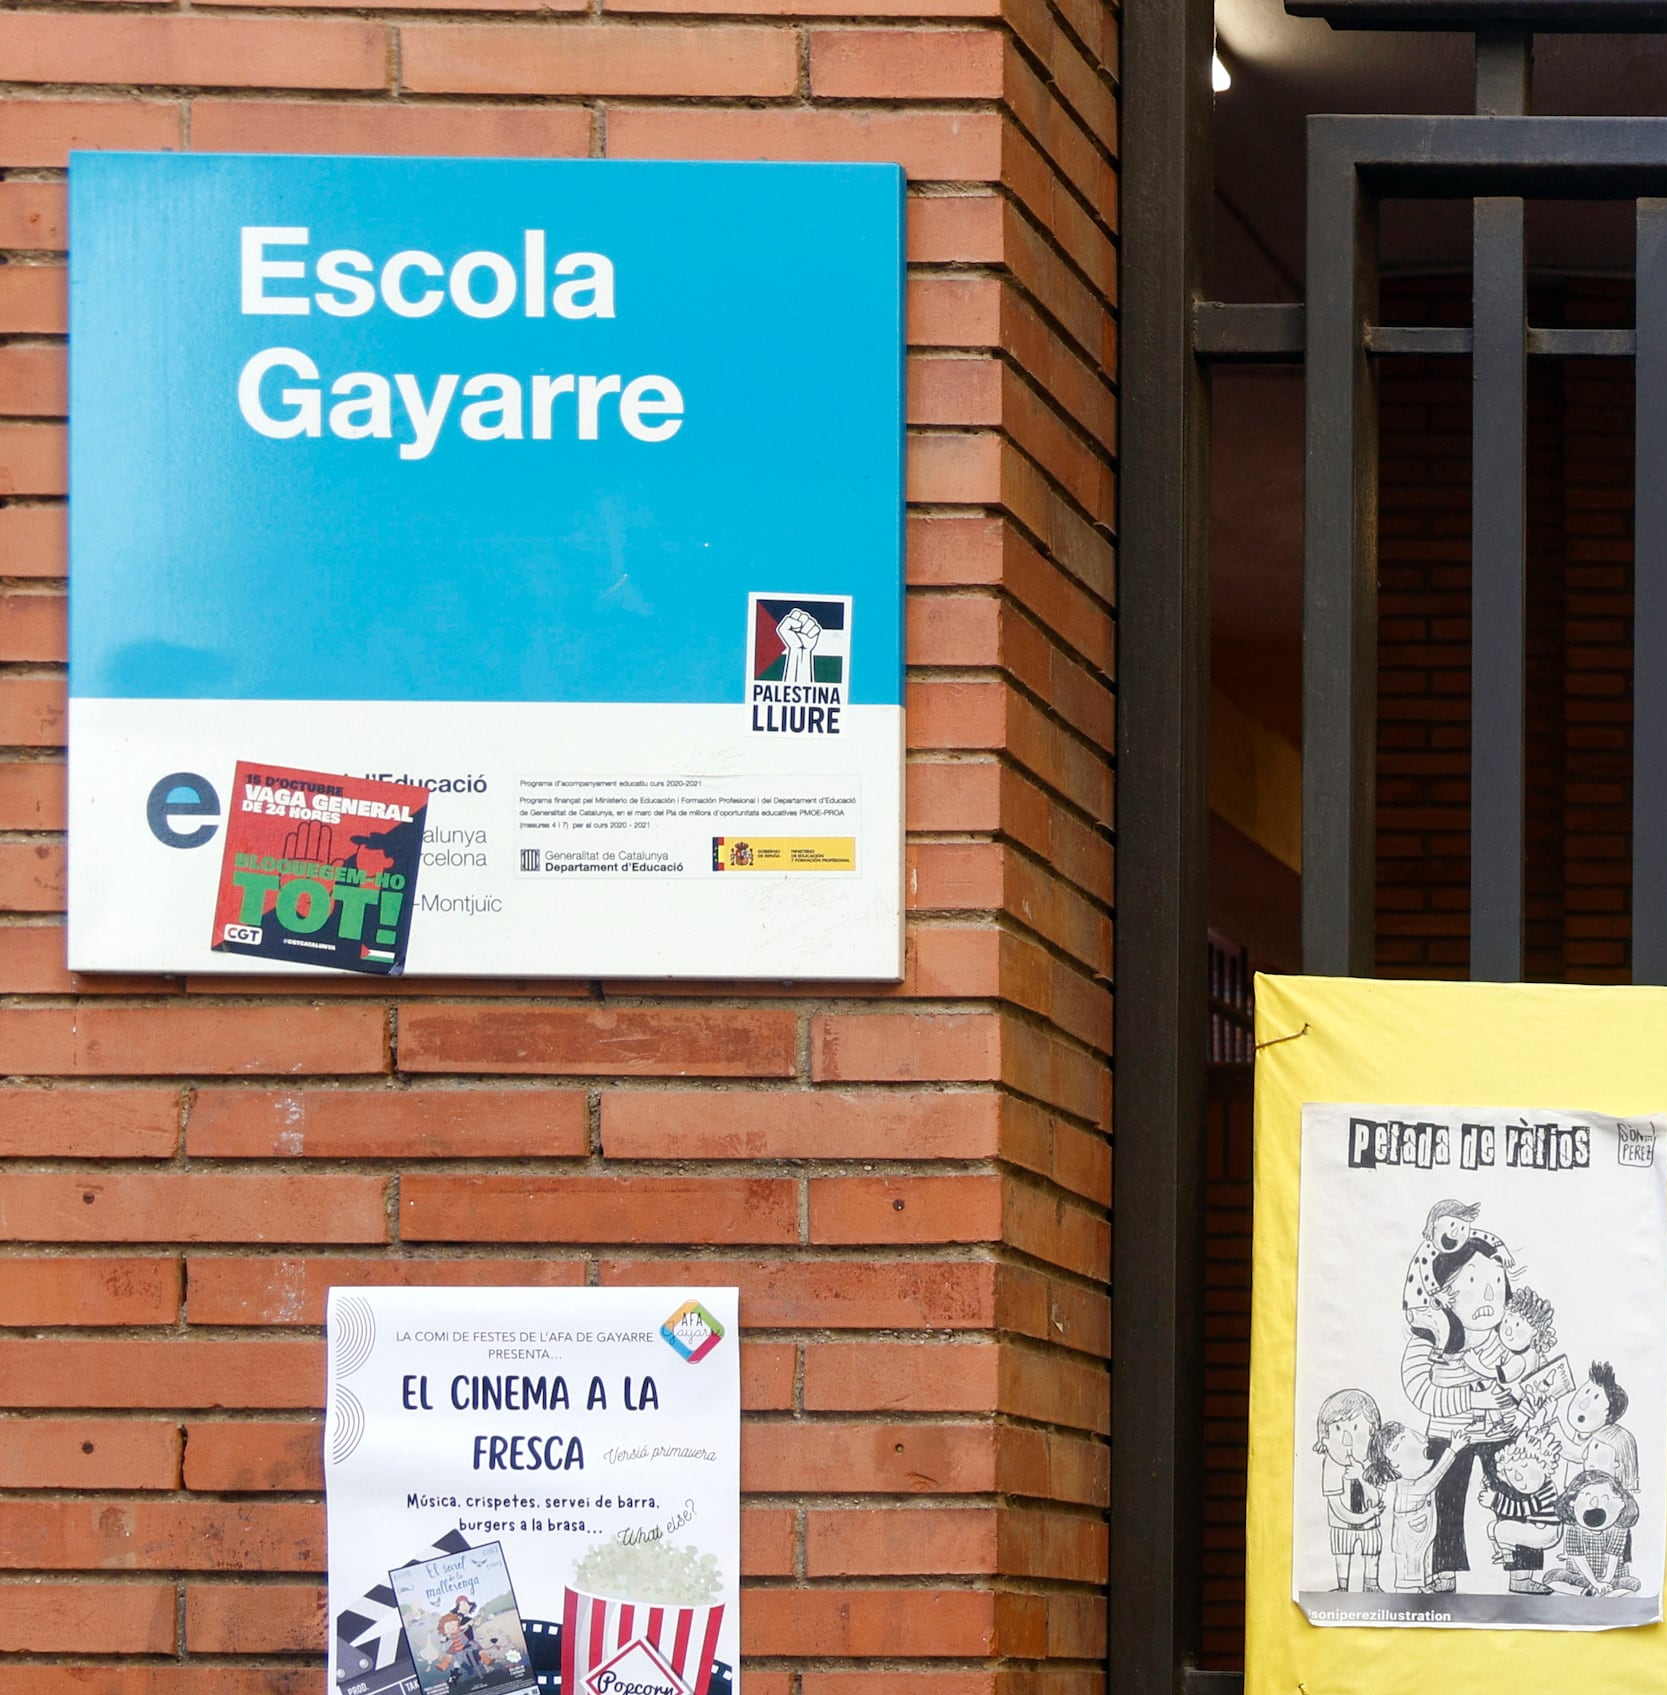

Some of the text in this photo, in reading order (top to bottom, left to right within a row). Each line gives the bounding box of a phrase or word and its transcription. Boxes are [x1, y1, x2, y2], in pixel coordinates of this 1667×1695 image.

[240, 227, 615, 319] Escola
[238, 348, 684, 460] Gayarre
[753, 685, 840, 704] PALESTINA
[752, 705, 840, 734] LLIURE
[246, 774, 343, 796] 15 D'OCTUBRE
[242, 800, 341, 824] DE 24 HORES
[245, 784, 413, 823] VAGA GENERAL
[423, 826, 487, 848] alunya
[545, 850, 669, 862] Generalitat de Catalunya
[235, 853, 406, 890] BLOQUEGEM-HO
[545, 862, 683, 873] Departament d'Educació
[233, 870, 403, 945] TOT!
[413, 894, 502, 916] -Montjuïc
[227, 927, 260, 942] CGT
[1460, 1123, 1495, 1170] de
[1505, 1117, 1591, 1171] ràtios
[681, 1312, 703, 1326] AFA
[396, 1331, 654, 1342] LA COMI DE FESTES DE L'AFA DE GAYARRE
[402, 1375, 659, 1411] EL CINEMA A LA
[473, 1435, 584, 1471] FRESCA
[650, 1445, 717, 1462] primavera
[545, 1496, 590, 1508] servei
[595, 1494, 612, 1508] de
[459, 1517, 515, 1533] burgers
[520, 1521, 527, 1531] a
[532, 1518, 542, 1531] la
[617, 1498, 698, 1546] What else?
[405, 1679, 420, 1692] TAK
